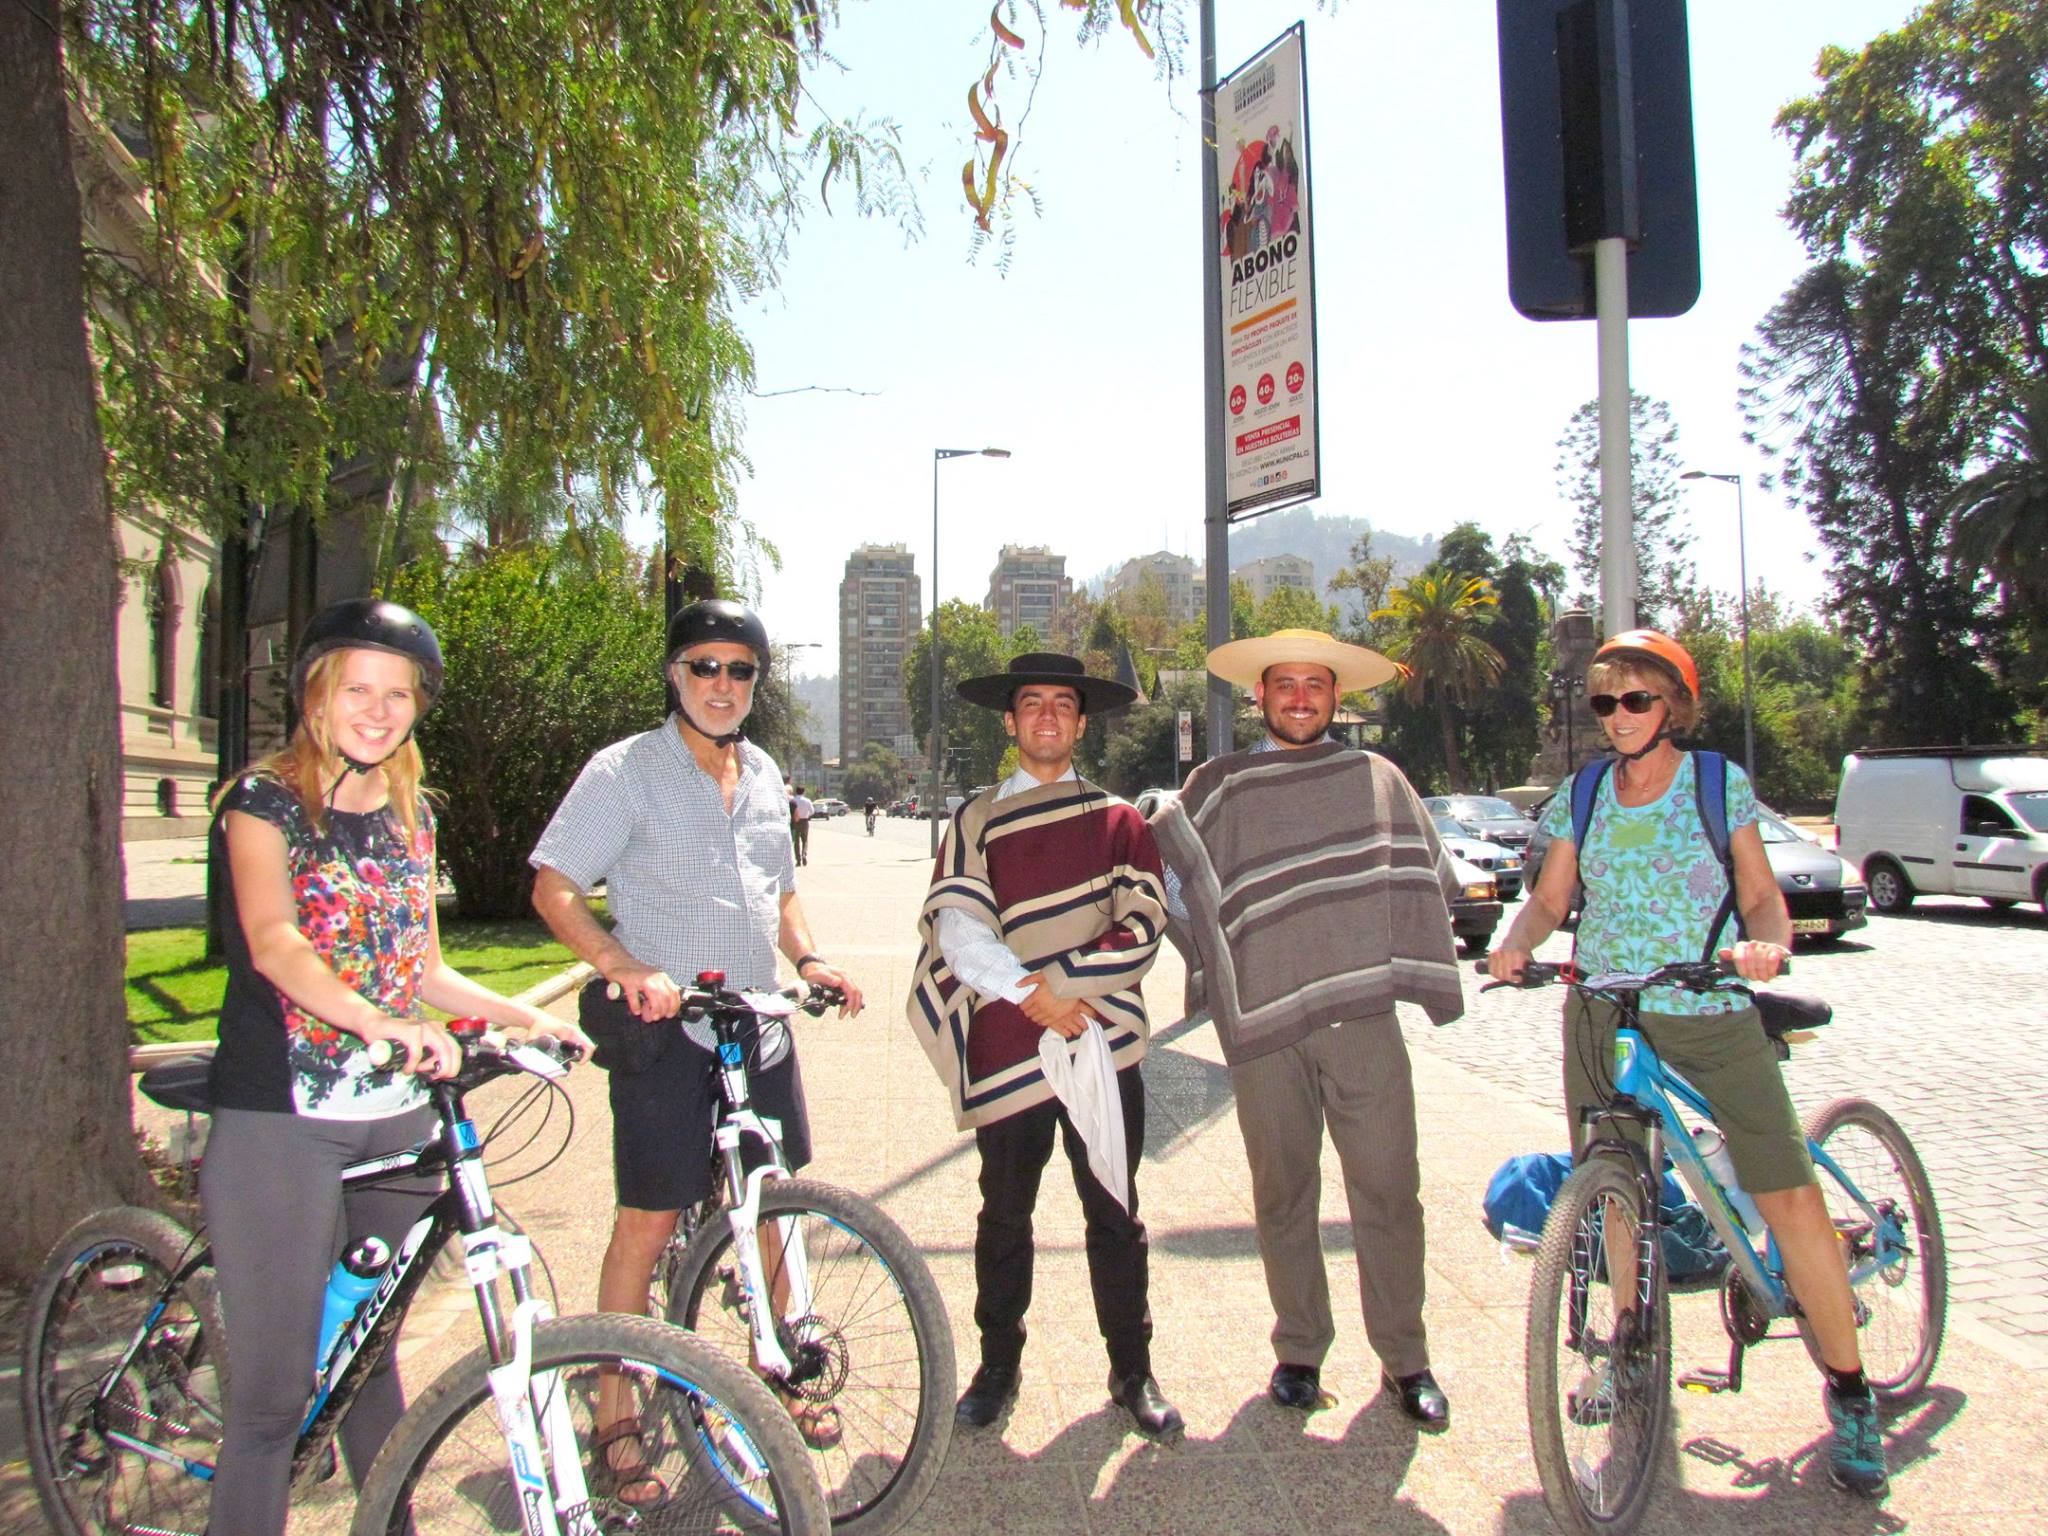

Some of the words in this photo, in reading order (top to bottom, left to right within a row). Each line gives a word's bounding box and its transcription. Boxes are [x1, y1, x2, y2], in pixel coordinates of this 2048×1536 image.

[1230, 257, 1297, 318] FLEXIBLE
[1232, 235, 1297, 287] ABONO
[348, 1242, 412, 1352] TREK
